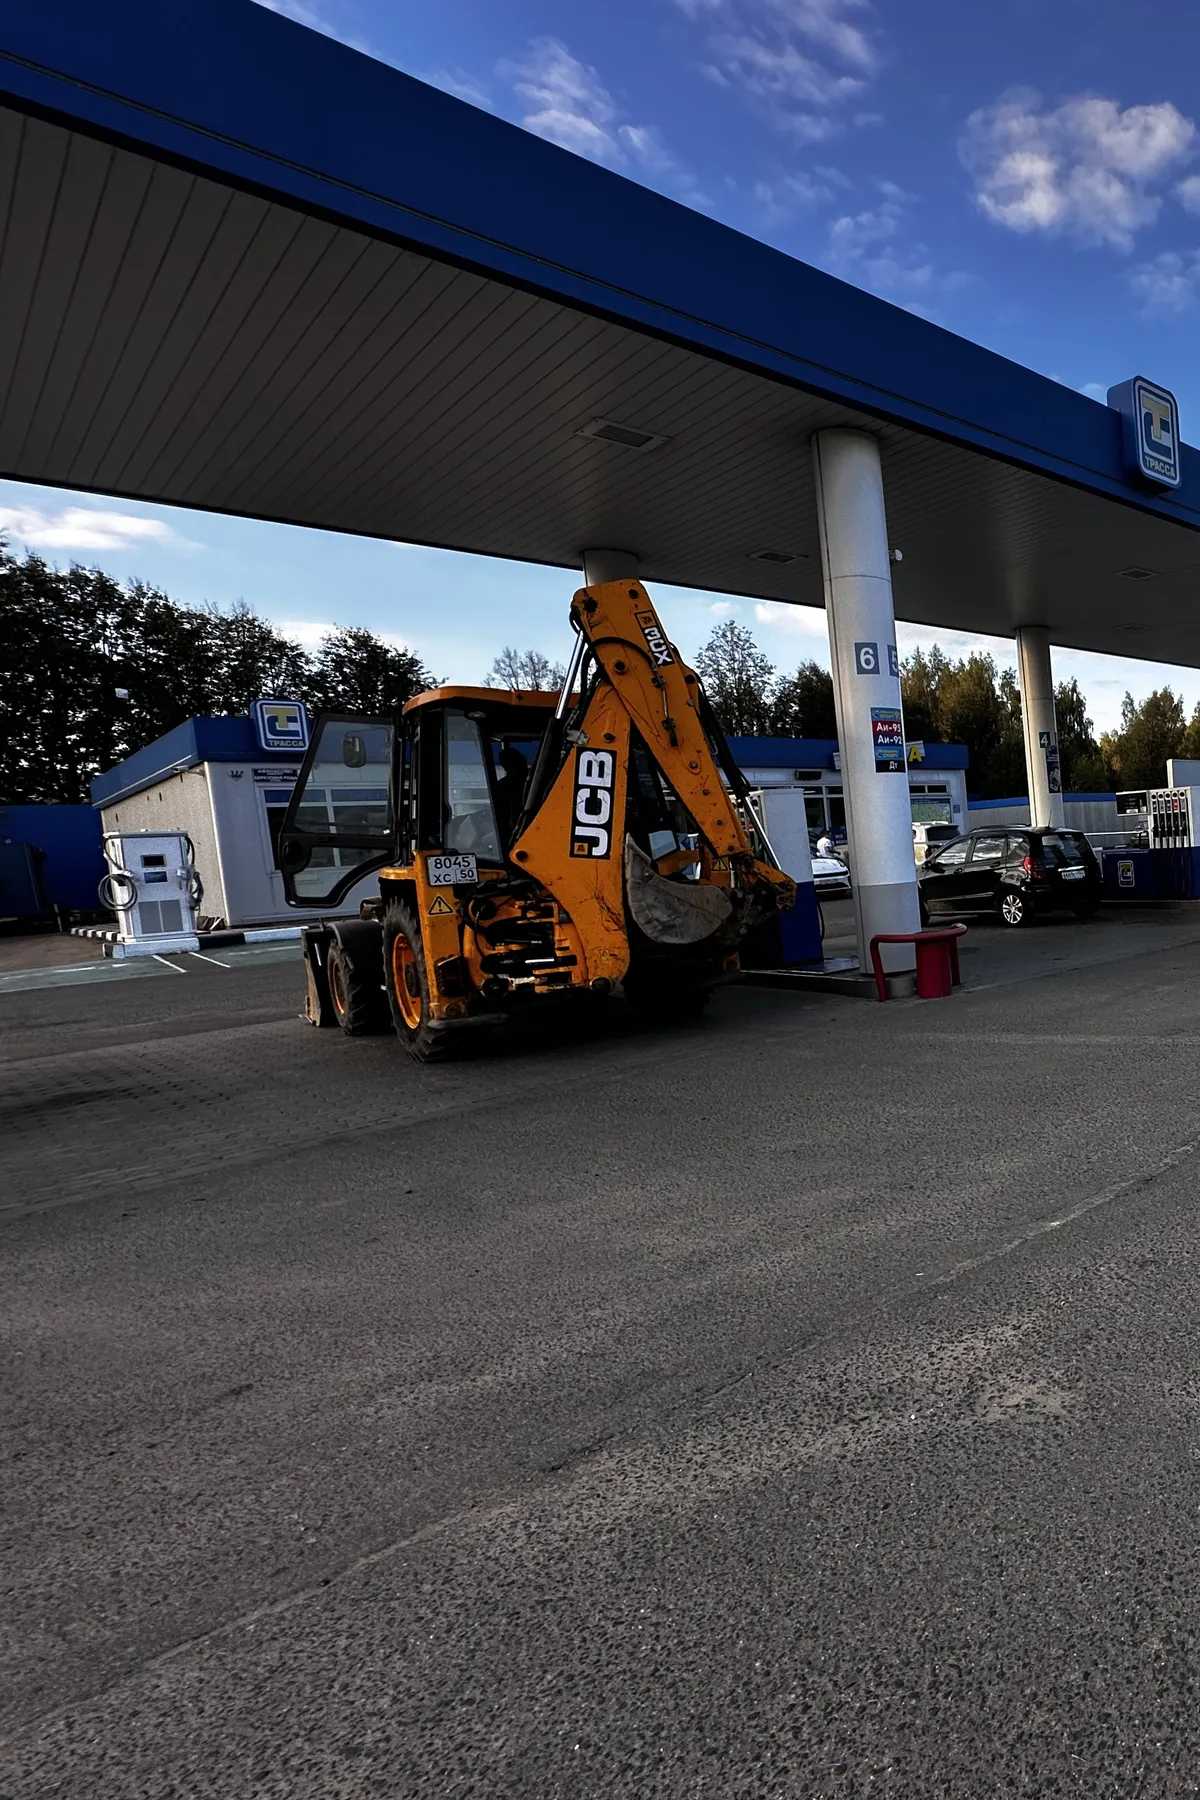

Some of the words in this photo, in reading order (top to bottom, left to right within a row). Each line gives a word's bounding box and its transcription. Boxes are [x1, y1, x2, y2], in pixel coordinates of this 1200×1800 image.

[1144, 455, 1176, 478] ТРАССА
[644, 627, 673, 665] 3CX
[859, 647, 875, 670] 6
[876, 722, 901, 733] Аи-95
[877, 735, 903, 745] Аи-92
[1040, 734, 1049, 746] 4
[889, 761, 898, 770] Дт
[575, 751, 613, 856] JCB
[434, 856, 471, 869] 8045
[460, 869, 474, 878] 50
